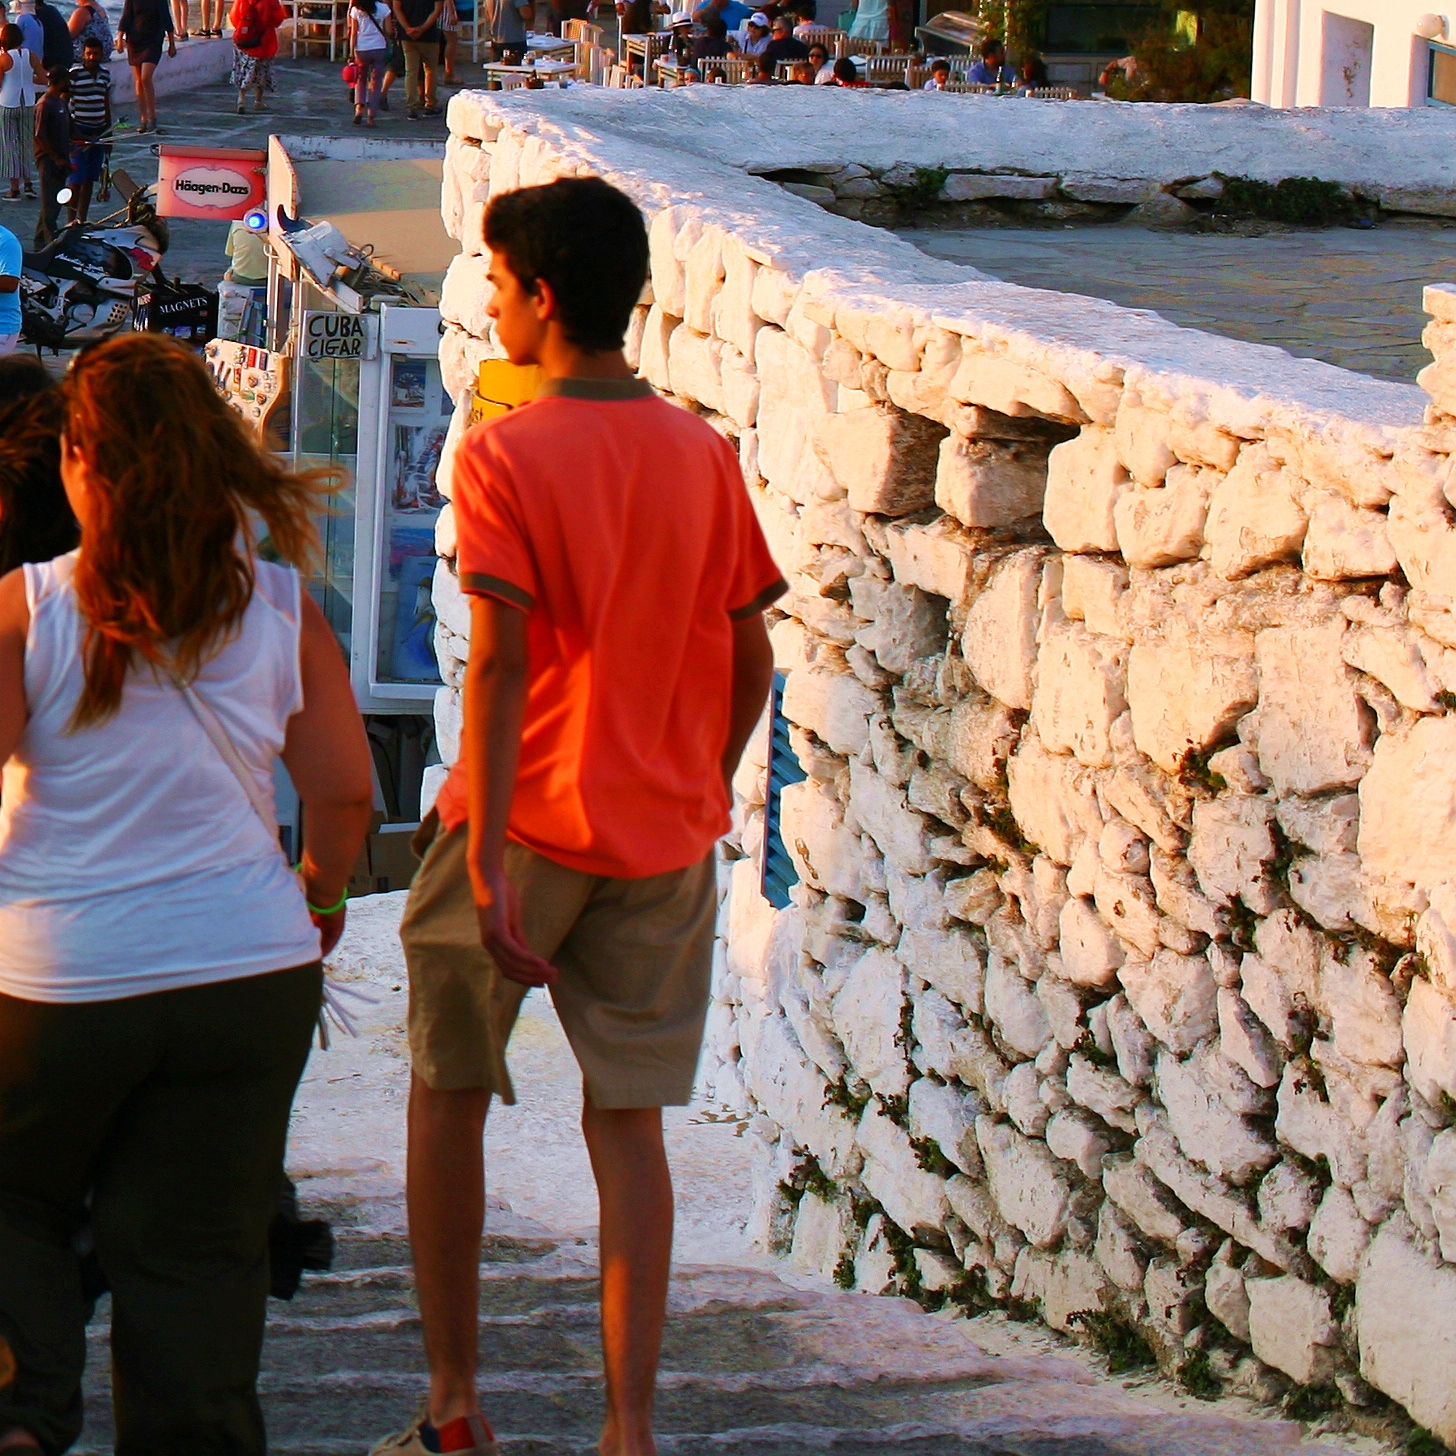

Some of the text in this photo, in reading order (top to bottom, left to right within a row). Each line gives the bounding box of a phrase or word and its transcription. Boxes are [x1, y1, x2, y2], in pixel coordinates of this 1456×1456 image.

[175, 179, 249, 195] Häagen-Dazs
[159, 297, 208, 314] MAGNETS
[309, 315, 364, 337] CUBA
[308, 338, 361, 356] CIGAR
